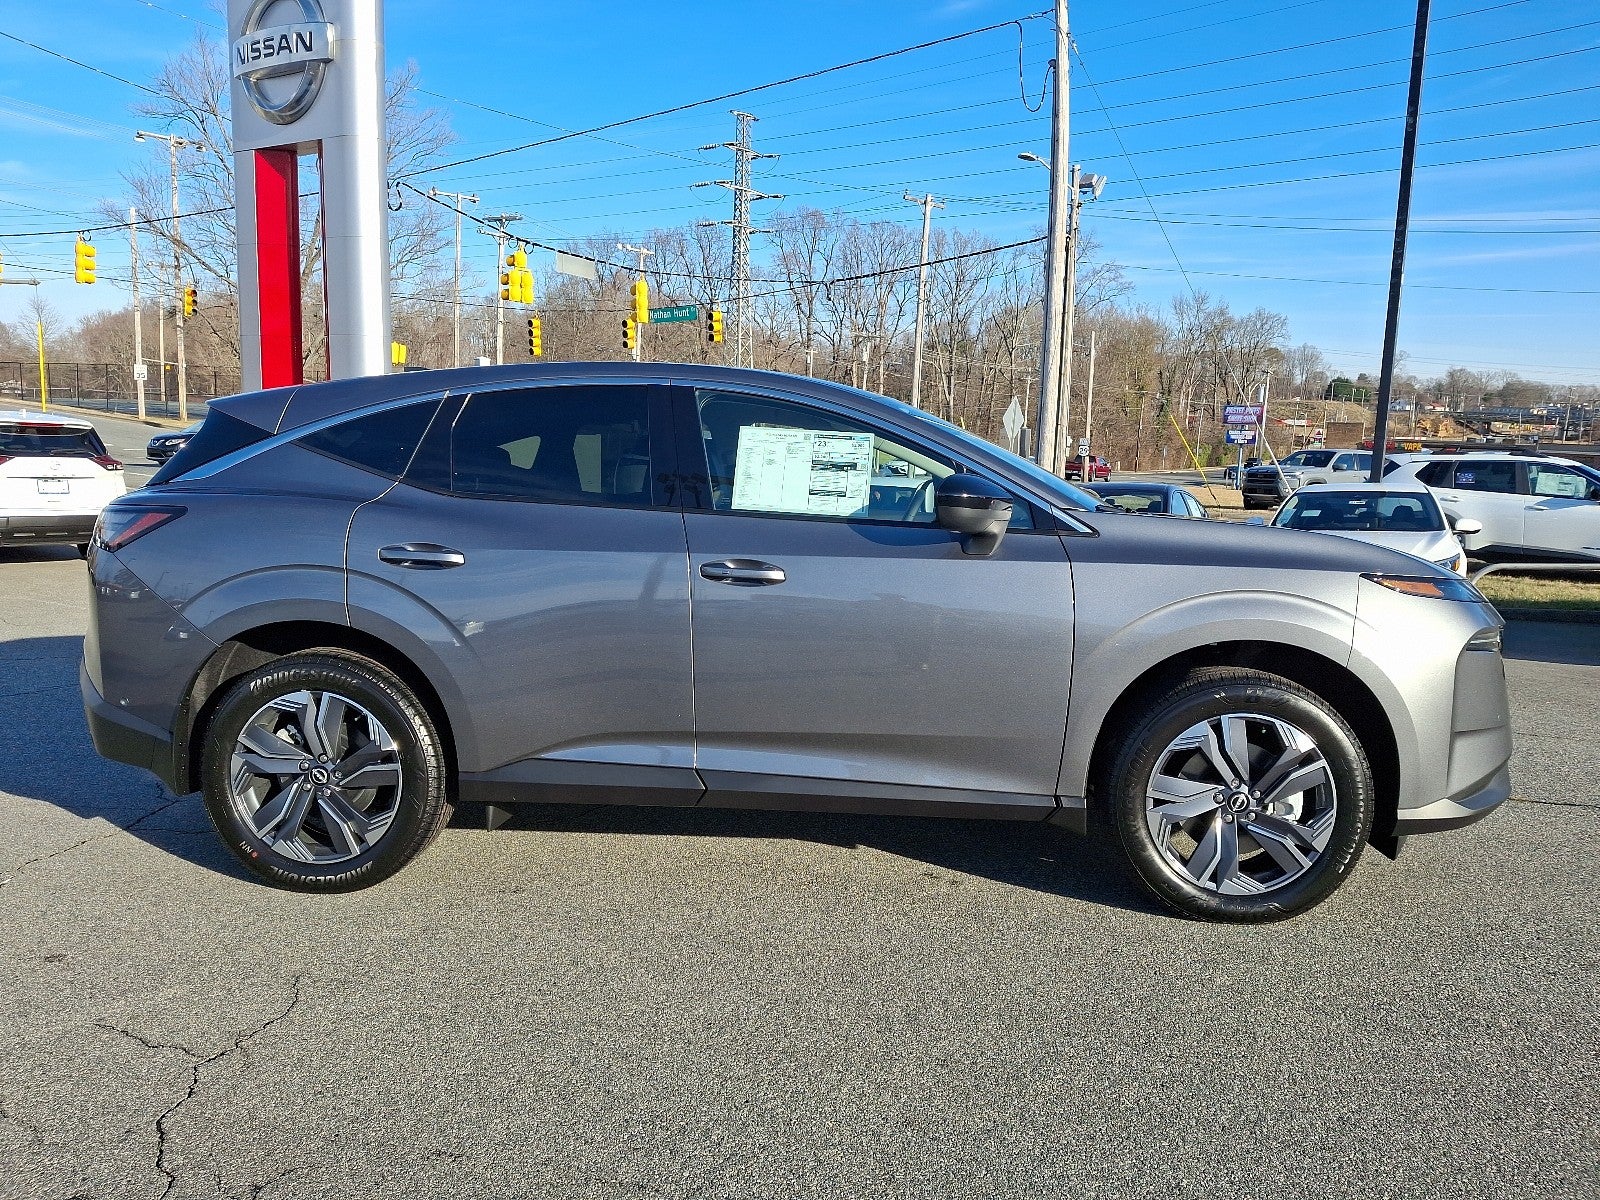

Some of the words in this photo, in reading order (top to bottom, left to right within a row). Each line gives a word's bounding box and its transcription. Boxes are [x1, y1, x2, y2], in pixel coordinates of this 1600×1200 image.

[236, 31, 313, 66] NISSAN
[649, 310, 672, 320] Nathan
[673, 308, 690, 317] Hunt
